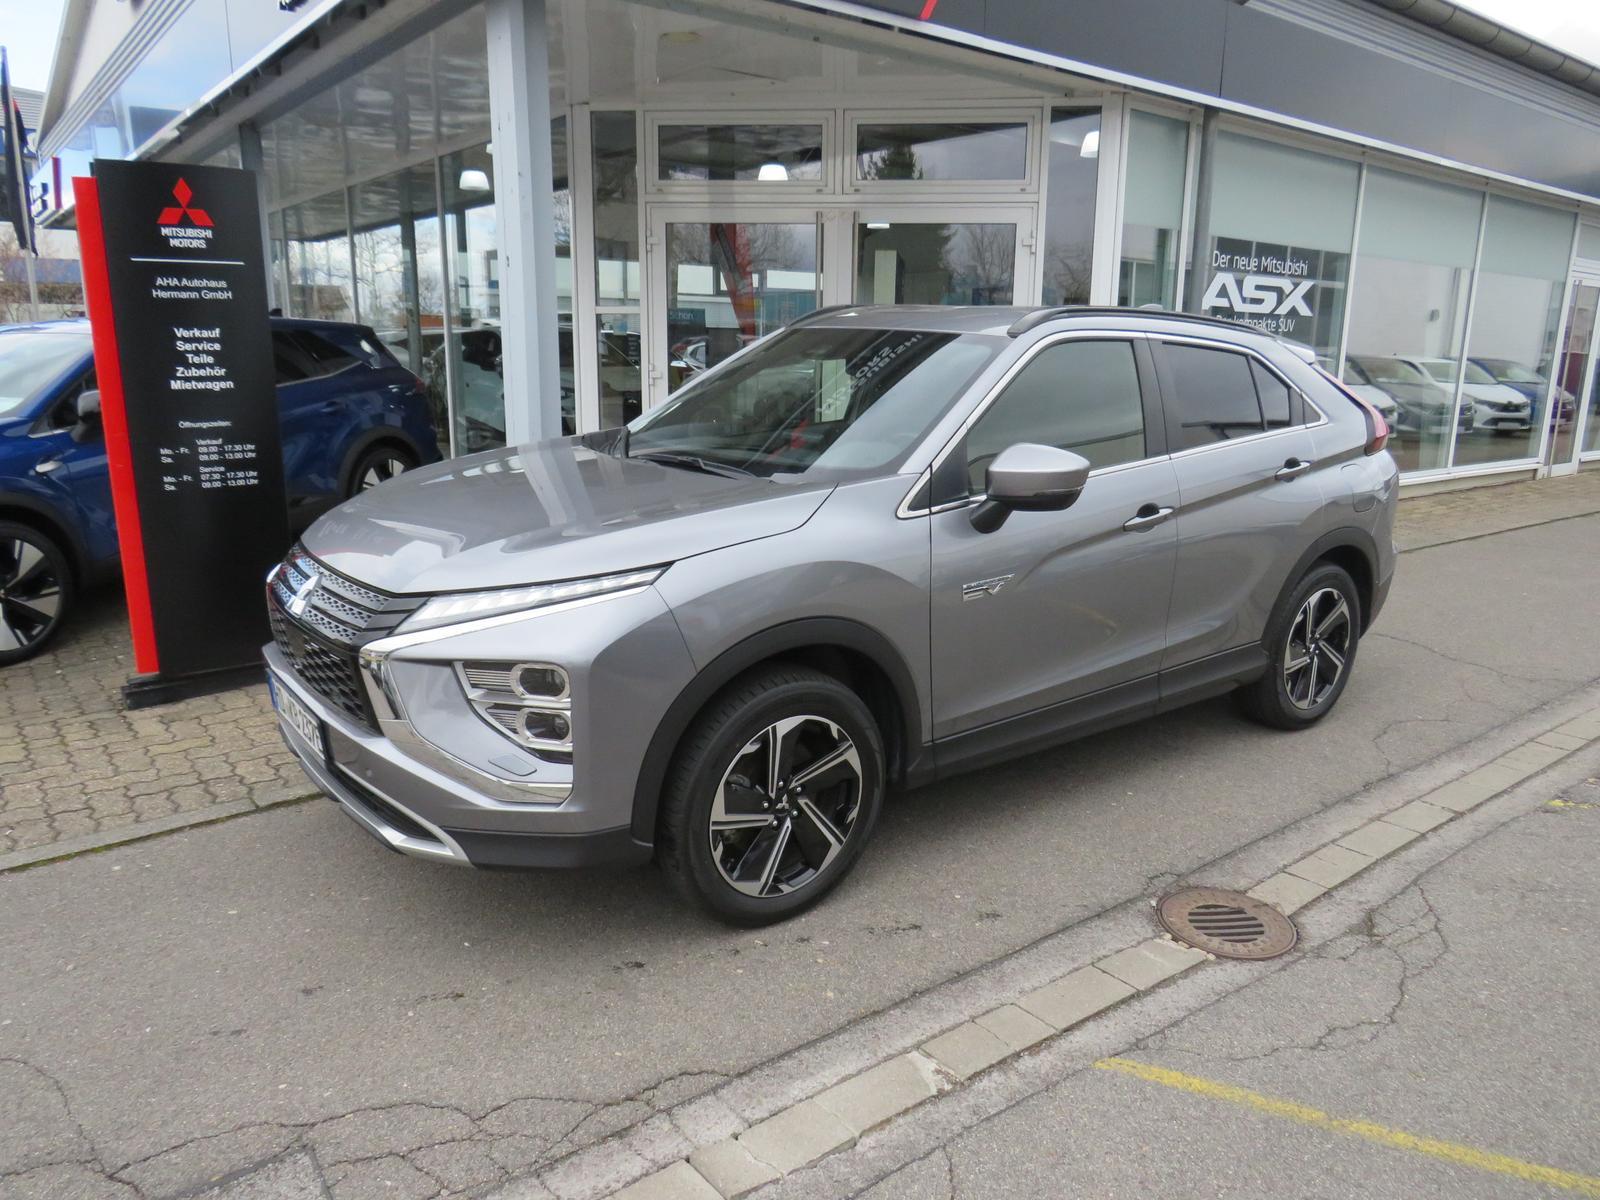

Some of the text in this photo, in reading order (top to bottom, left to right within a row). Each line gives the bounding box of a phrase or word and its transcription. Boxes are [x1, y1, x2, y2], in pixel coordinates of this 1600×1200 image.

[161, 227, 213, 238] MITSUBISHI
[169, 238, 207, 248] MOTORS
[1212, 250, 1308, 276] Der neue Mitsubishi
[155, 277, 227, 288] AHA Autohaus
[152, 290, 232, 300] Hermann GmbH
[1201, 272, 1315, 317] ASX
[1278, 318, 1296, 332] SUV
[173, 328, 220, 338] Verkauf
[176, 341, 221, 351] Service
[186, 354, 214, 364] Teile
[176, 367, 226, 377] Zubehör
[170, 380, 234, 391] Mietwagen
